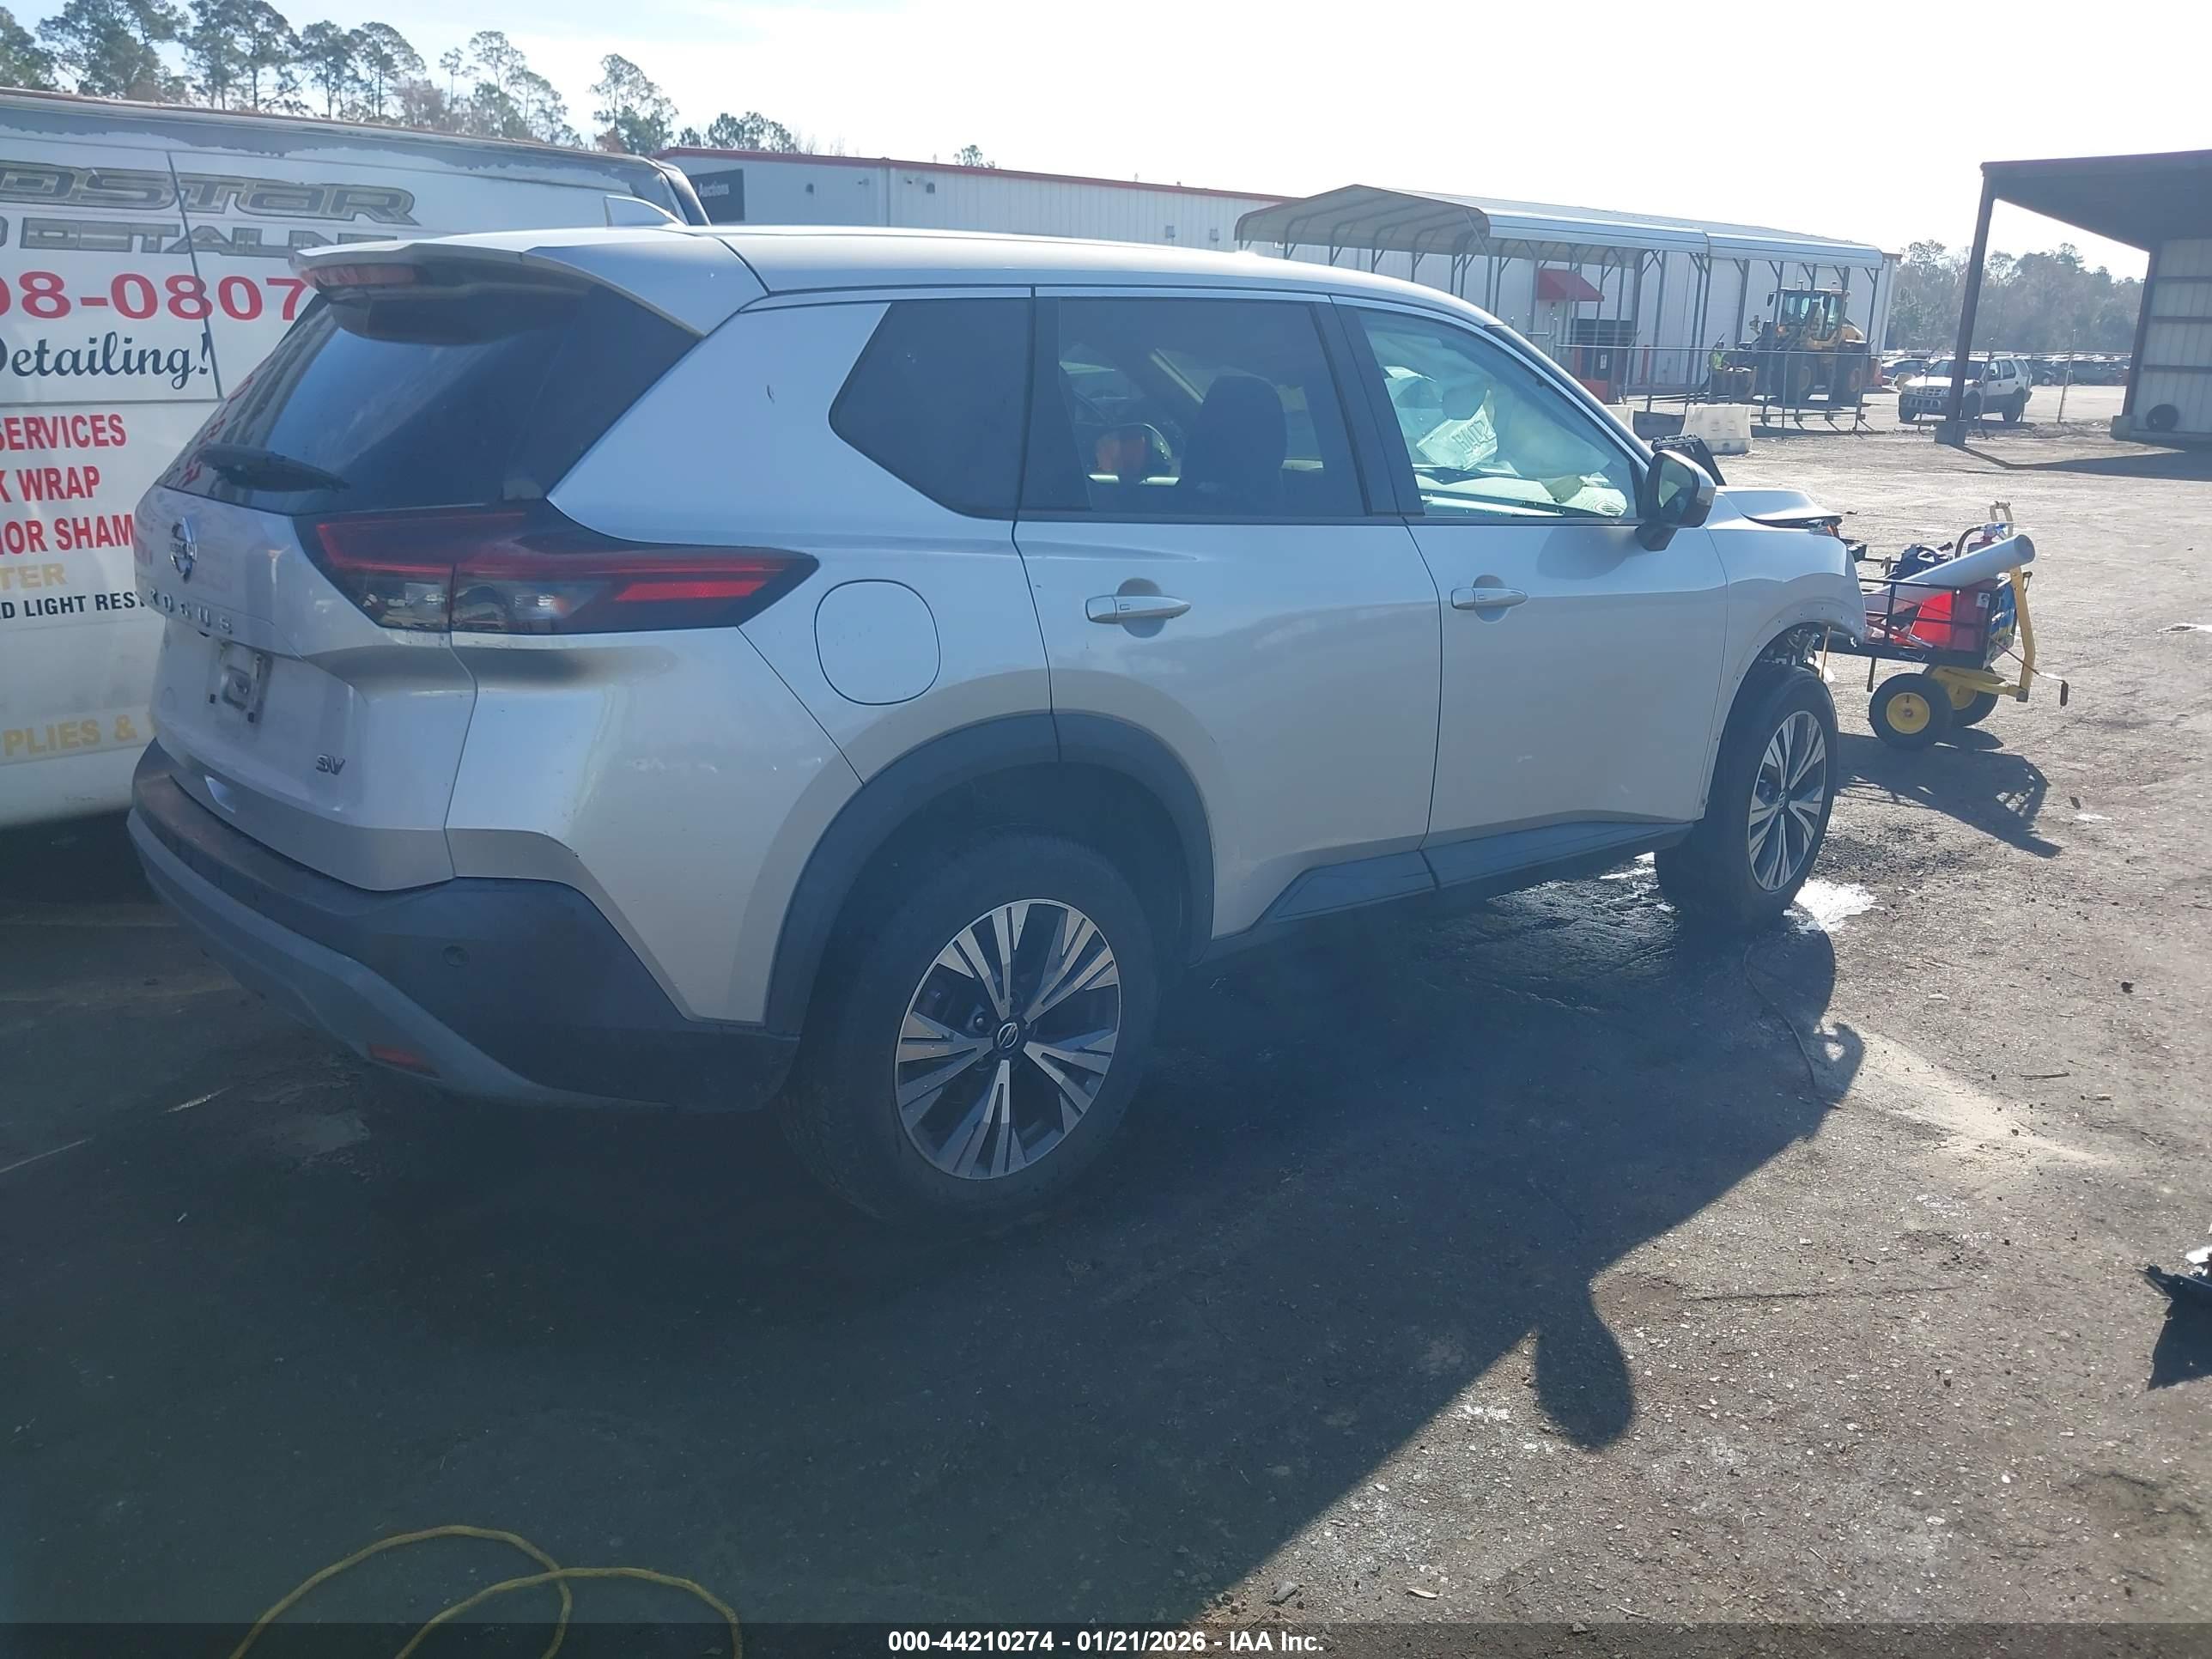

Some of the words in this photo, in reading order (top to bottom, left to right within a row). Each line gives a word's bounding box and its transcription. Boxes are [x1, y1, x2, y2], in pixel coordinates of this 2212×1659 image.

[0, 271, 307, 321] 8-0807
[0, 331, 209, 390] etailing!
[15, 465, 100, 501] WRAP
[24, 596, 87, 617] LIGHT
[114, 714, 138, 741] &
[315, 754, 345, 775] SV
